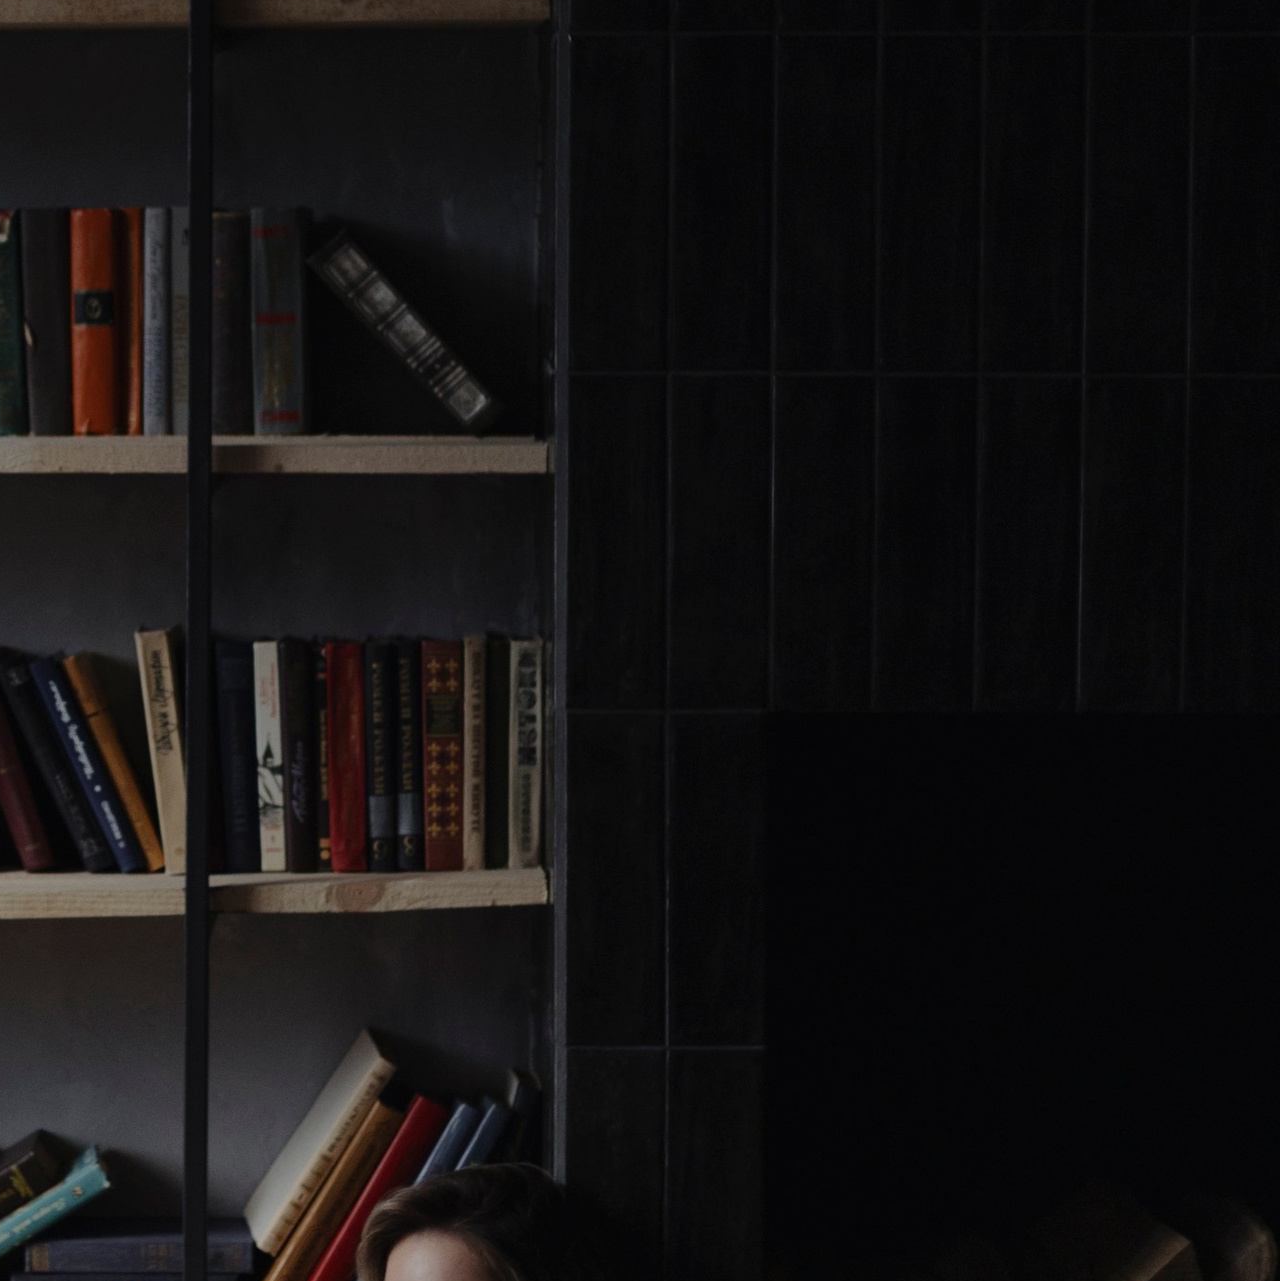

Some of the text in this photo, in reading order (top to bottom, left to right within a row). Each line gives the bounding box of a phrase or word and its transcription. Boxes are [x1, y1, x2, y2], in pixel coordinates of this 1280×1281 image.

[370, 661, 385, 794] РОМЕН РОЛЛАН
[398, 658, 413, 791] РОМЕН РОЛЛАН
